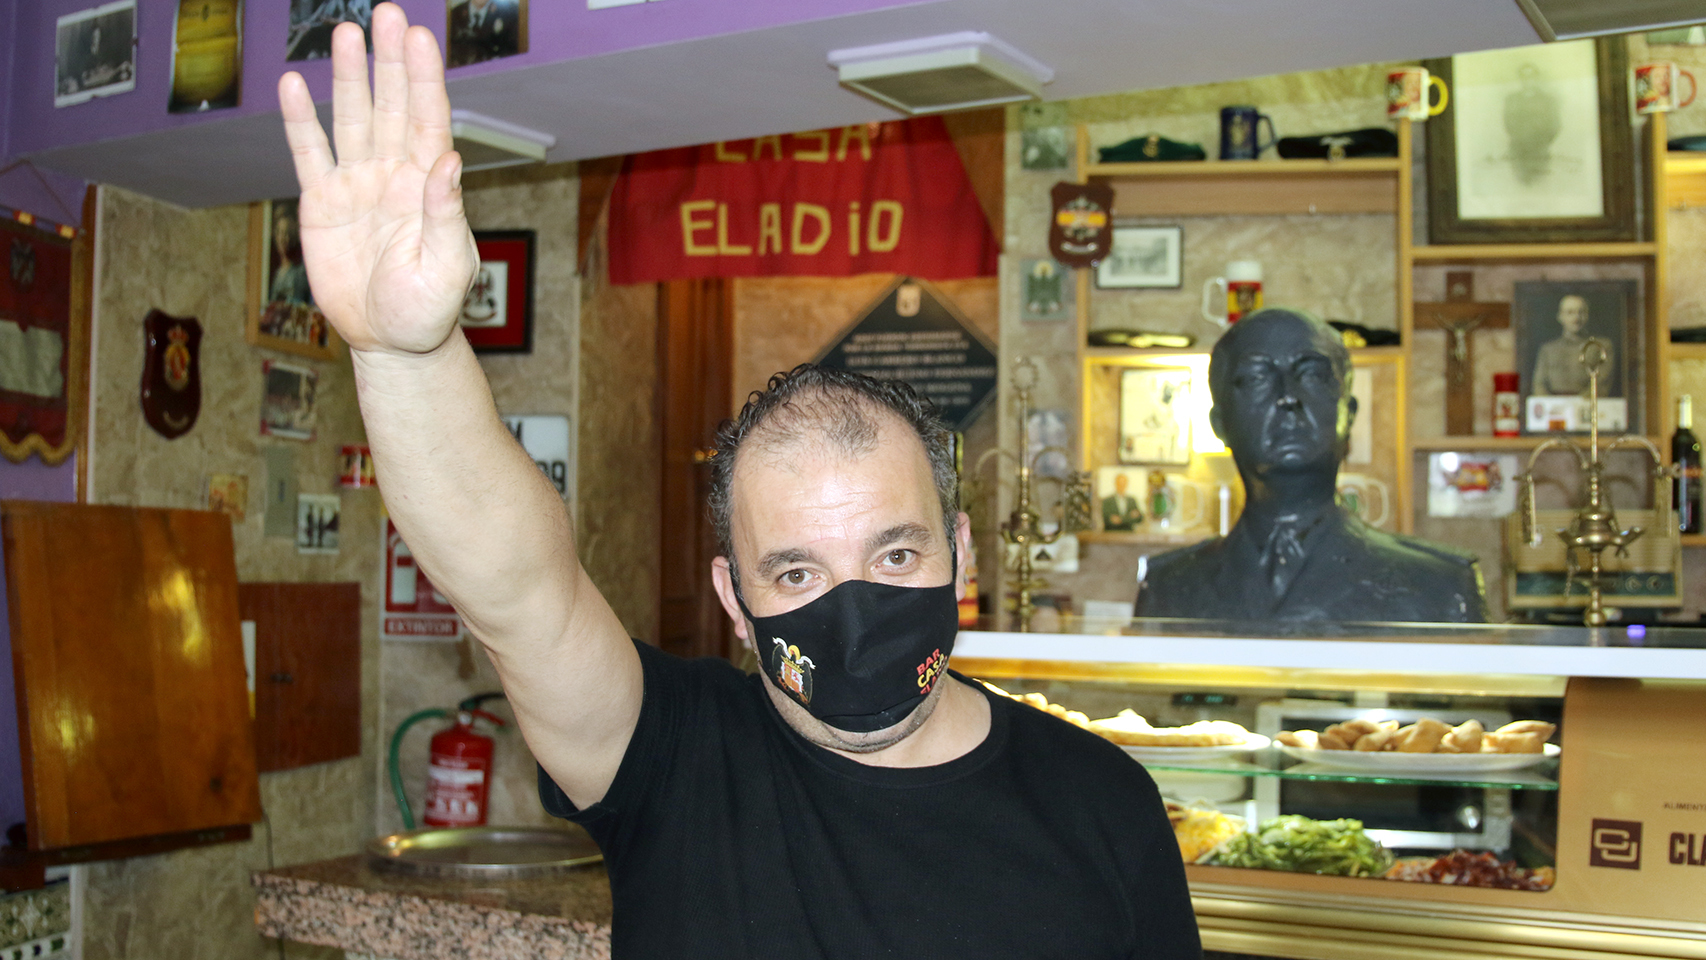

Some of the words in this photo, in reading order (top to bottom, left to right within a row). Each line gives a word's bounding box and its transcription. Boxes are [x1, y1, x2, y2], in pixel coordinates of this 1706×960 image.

[388, 621, 453, 632] EXTINTOR
[916, 648, 940, 675] BAR
[917, 654, 945, 688] CASA
